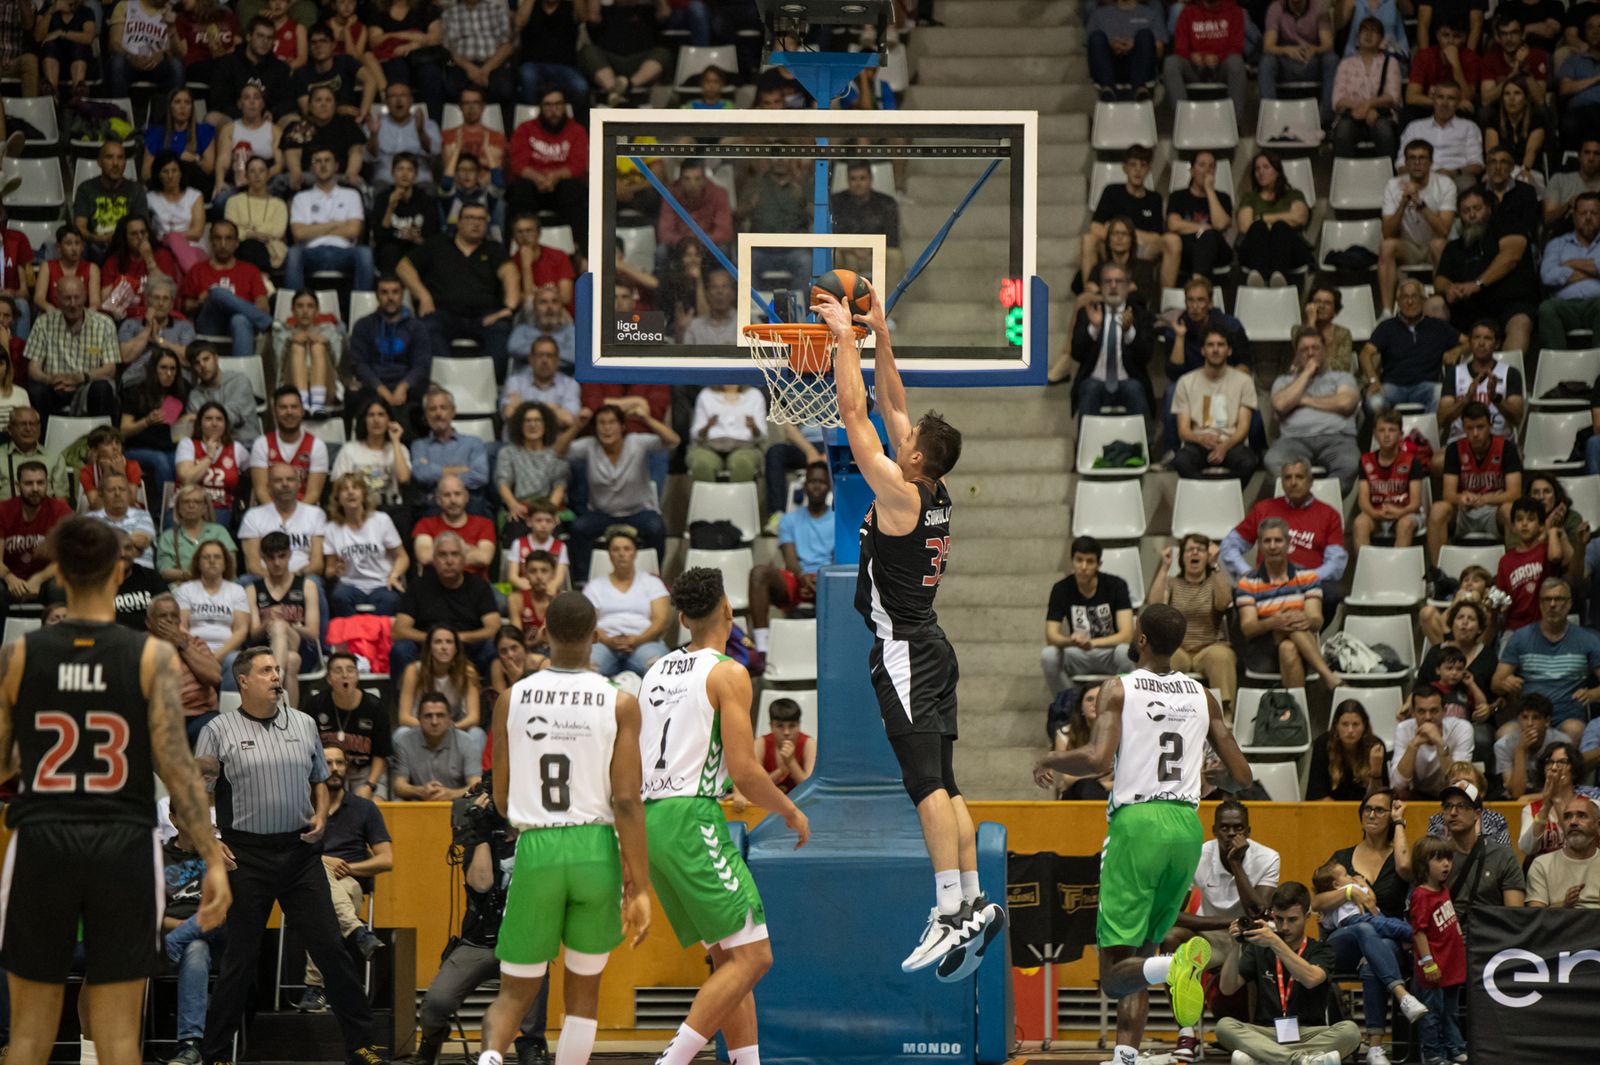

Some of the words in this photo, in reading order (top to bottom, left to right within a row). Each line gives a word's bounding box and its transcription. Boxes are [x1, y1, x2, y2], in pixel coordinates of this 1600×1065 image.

[617, 320, 638, 332] liga
[617, 331, 663, 341] endesa
[203, 468, 225, 486] 22
[5, 534, 46, 553] GIRON
[660, 657, 697, 675] TYSON
[58, 663, 107, 691] HILL
[1134, 678, 1184, 694] JOHNSON
[1183, 680, 1199, 694] III
[520, 689, 605, 706] MONTERO
[32, 711, 130, 792] 23
[654, 716, 671, 769] 1
[1158, 731, 1184, 782] 2
[539, 753, 571, 812] 8
[903, 1042, 961, 1055] MONDO
